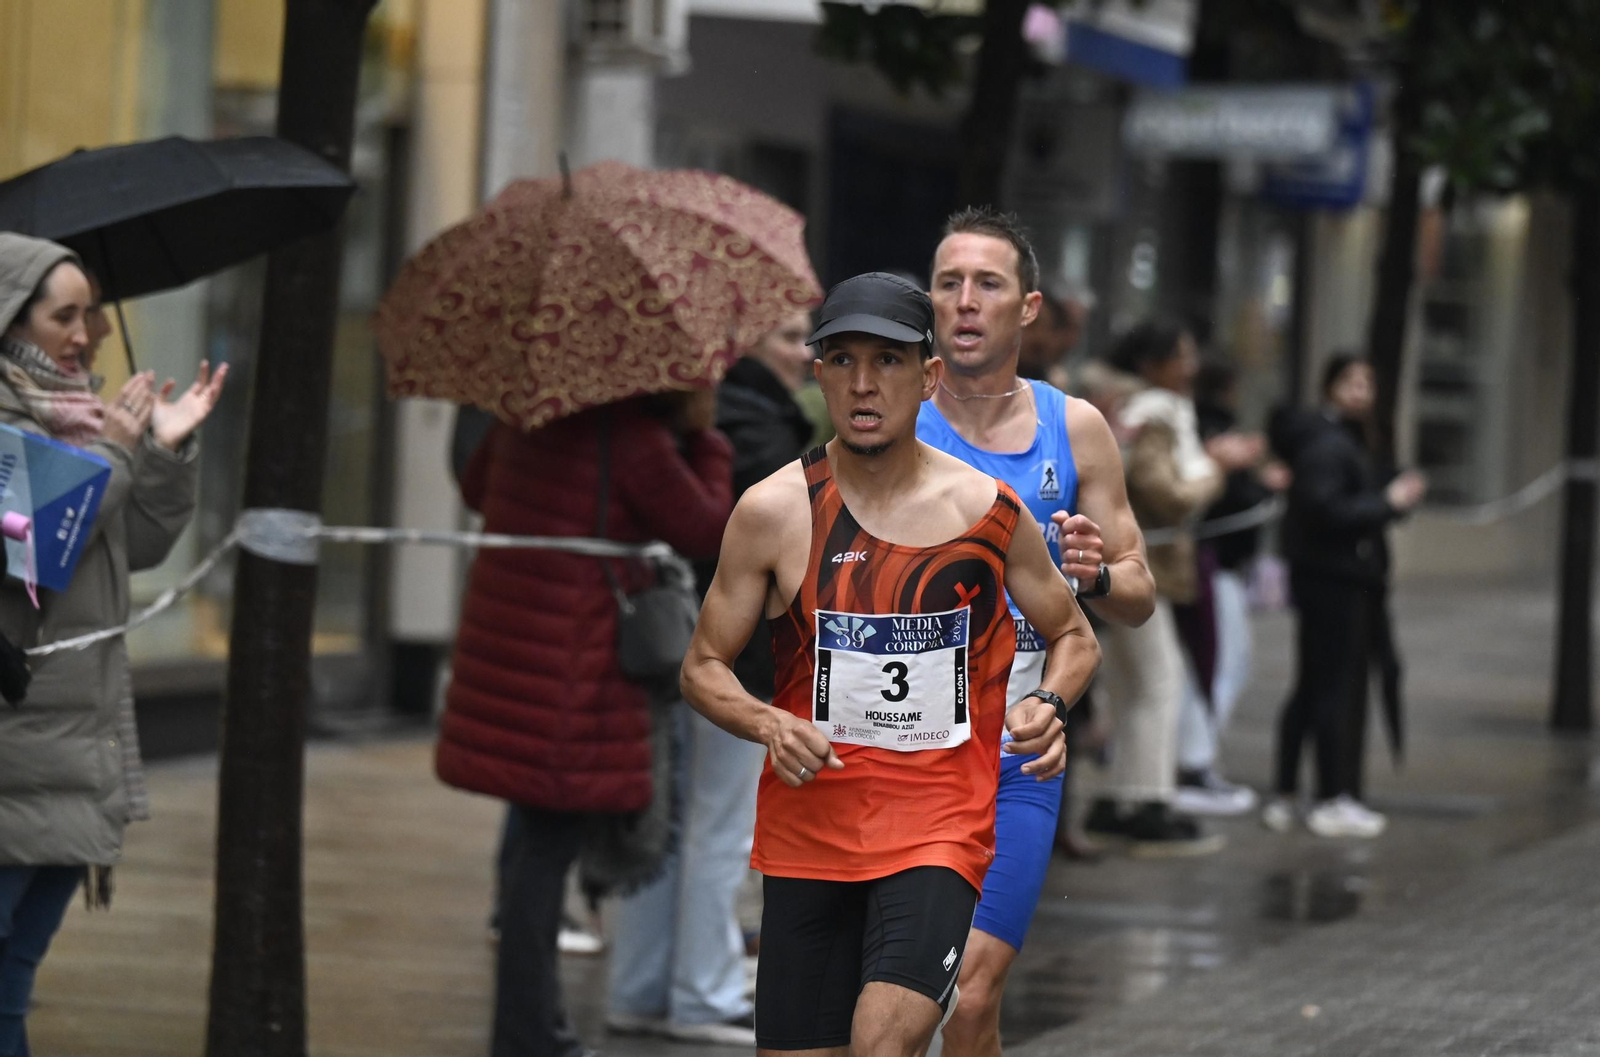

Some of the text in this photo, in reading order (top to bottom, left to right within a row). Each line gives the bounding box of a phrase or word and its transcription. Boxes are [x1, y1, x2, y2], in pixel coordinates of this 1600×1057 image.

[831, 551, 867, 563] 42K
[892, 617, 943, 631] MEDIA
[836, 627, 866, 649] 39
[892, 629, 942, 640] MARATÓN
[885, 639, 945, 652] CÓRDOBA
[819, 674, 828, 703] CAJÓN
[881, 661, 910, 703] 3
[865, 711, 922, 722] HOUSSAME
[873, 722, 900, 730] BENABBOU
[910, 729, 950, 742] IMDECO
